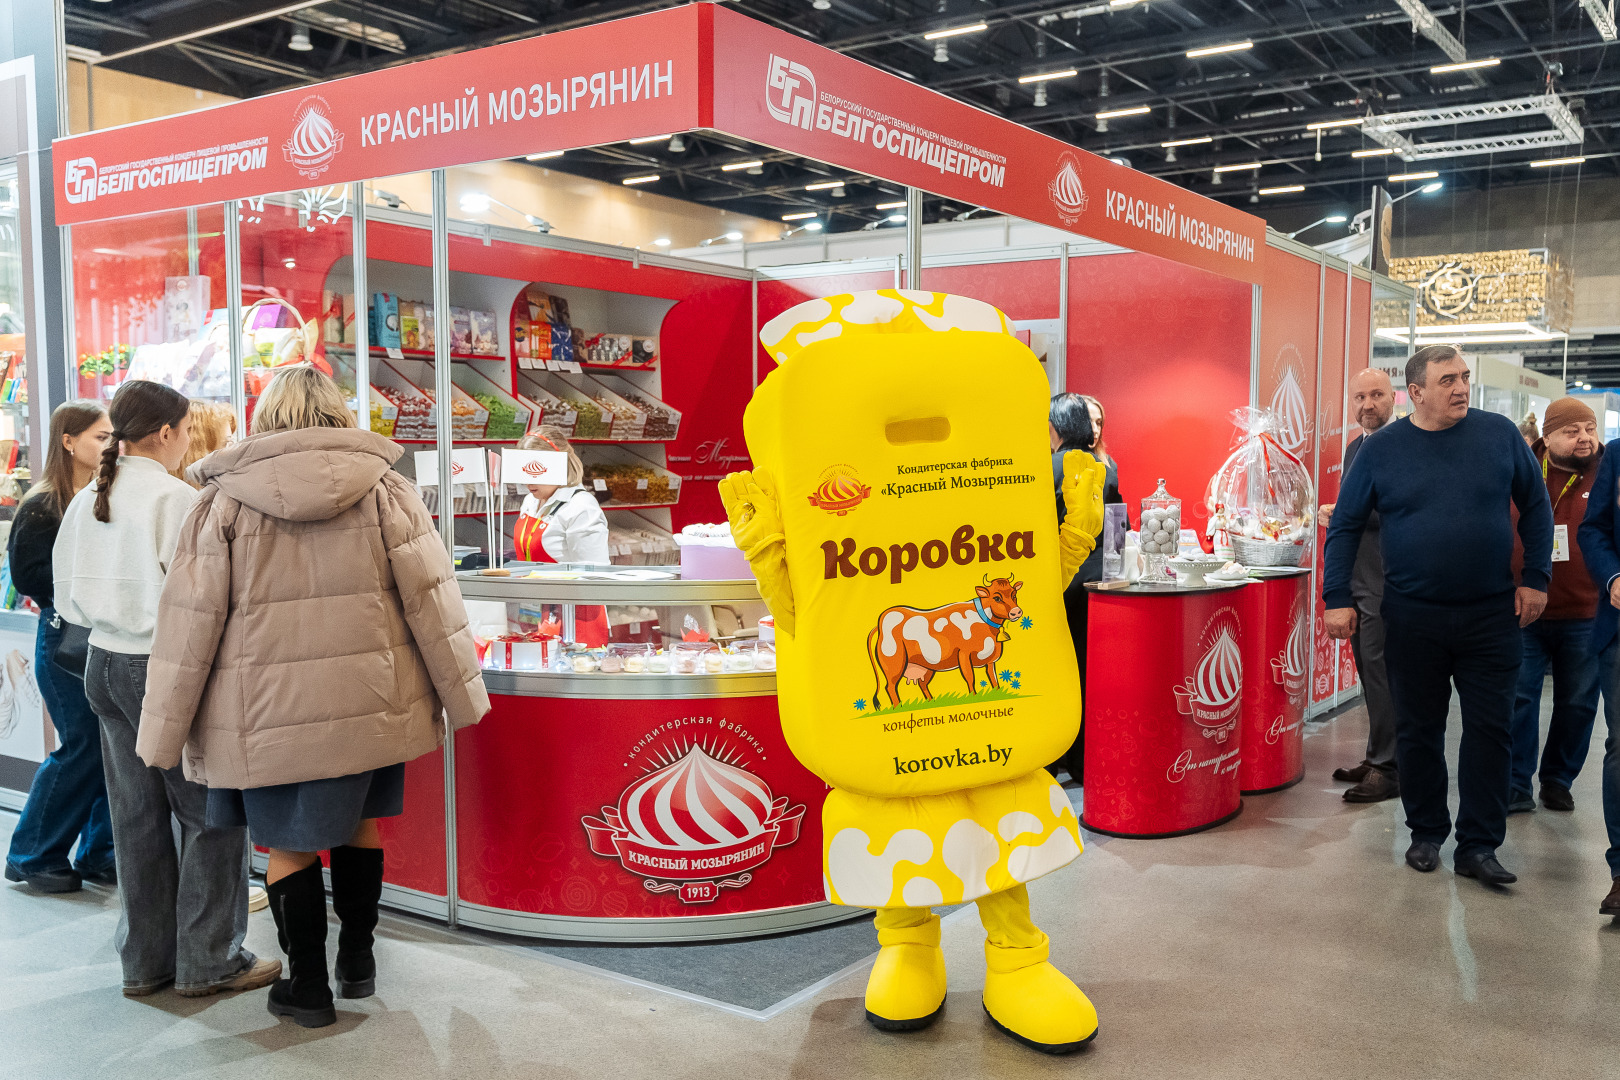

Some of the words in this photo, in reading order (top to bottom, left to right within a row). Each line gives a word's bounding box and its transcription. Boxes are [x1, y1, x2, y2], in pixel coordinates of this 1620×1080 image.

[361, 87, 479, 148] КРАСНЫЙ
[488, 59, 673, 125] МОЗЫРЯНИН
[815, 103, 1006, 188] БЕЛГОСПИЩЕПРОМ
[820, 91, 862, 113] БЕЛОРУССКИЙ
[862, 106, 915, 133] ГОСУДАРСТВЕННЫЙ
[916, 124, 939, 142] КОНЦЕРН
[939, 134, 964, 149] ПИЩЕВОЙ
[964, 140, 1007, 165] ПРОМЫШЛЕННОСТИ
[97, 146, 268, 197] БЕЛГОСПИЩЕПРОМ
[1106, 188, 1176, 239] КРАСНЫЙ
[1179, 214, 1255, 262] МОЗЫРЯНИН
[880, 478, 947, 498] «Красный
[950, 474, 1036, 491] Мозырянин»
[896, 460, 968, 476] Кондитерская
[970, 457, 1014, 471] фабрика
[820, 524, 1037, 585] Коровка
[628, 715, 713, 759] кондитерская
[719, 717, 764, 755] фабрика
[882, 712, 945, 734] конфеты
[948, 706, 1014, 724] молочные
[892, 743, 1013, 775] korovka.by
[628, 850, 689, 871] КРАСНЫЙ
[690, 842, 765, 871] МОЗЫРЯНИН
[686, 886, 711, 899] 1913
